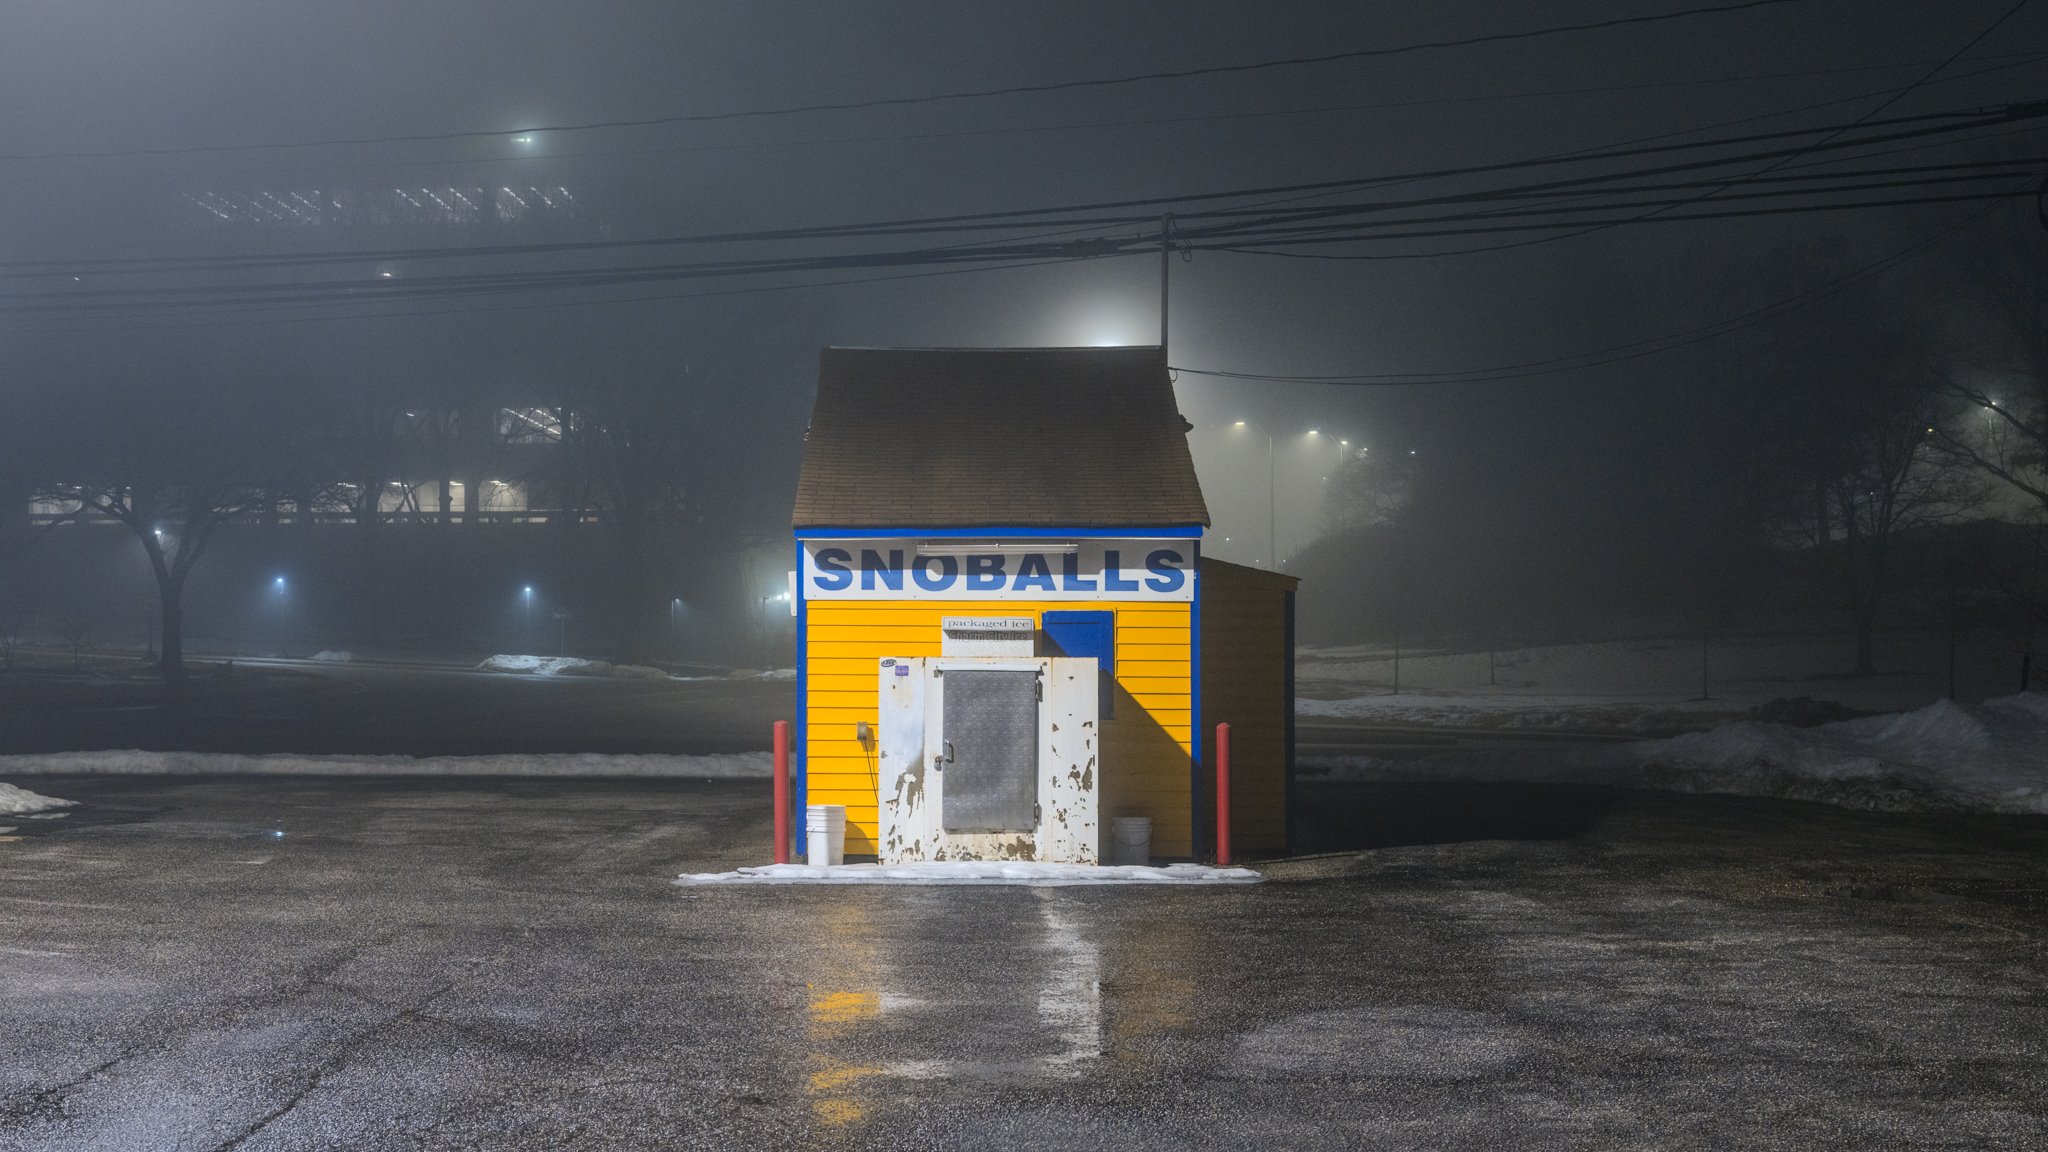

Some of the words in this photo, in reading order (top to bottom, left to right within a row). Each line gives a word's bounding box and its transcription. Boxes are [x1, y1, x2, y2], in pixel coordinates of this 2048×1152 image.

[813, 548, 1185, 592] SNOBALLS
[948, 619, 1007, 628] packaged
[1012, 619, 1029, 628] ice
[948, 631, 985, 641] Charm
[987, 631, 1009, 642] City
